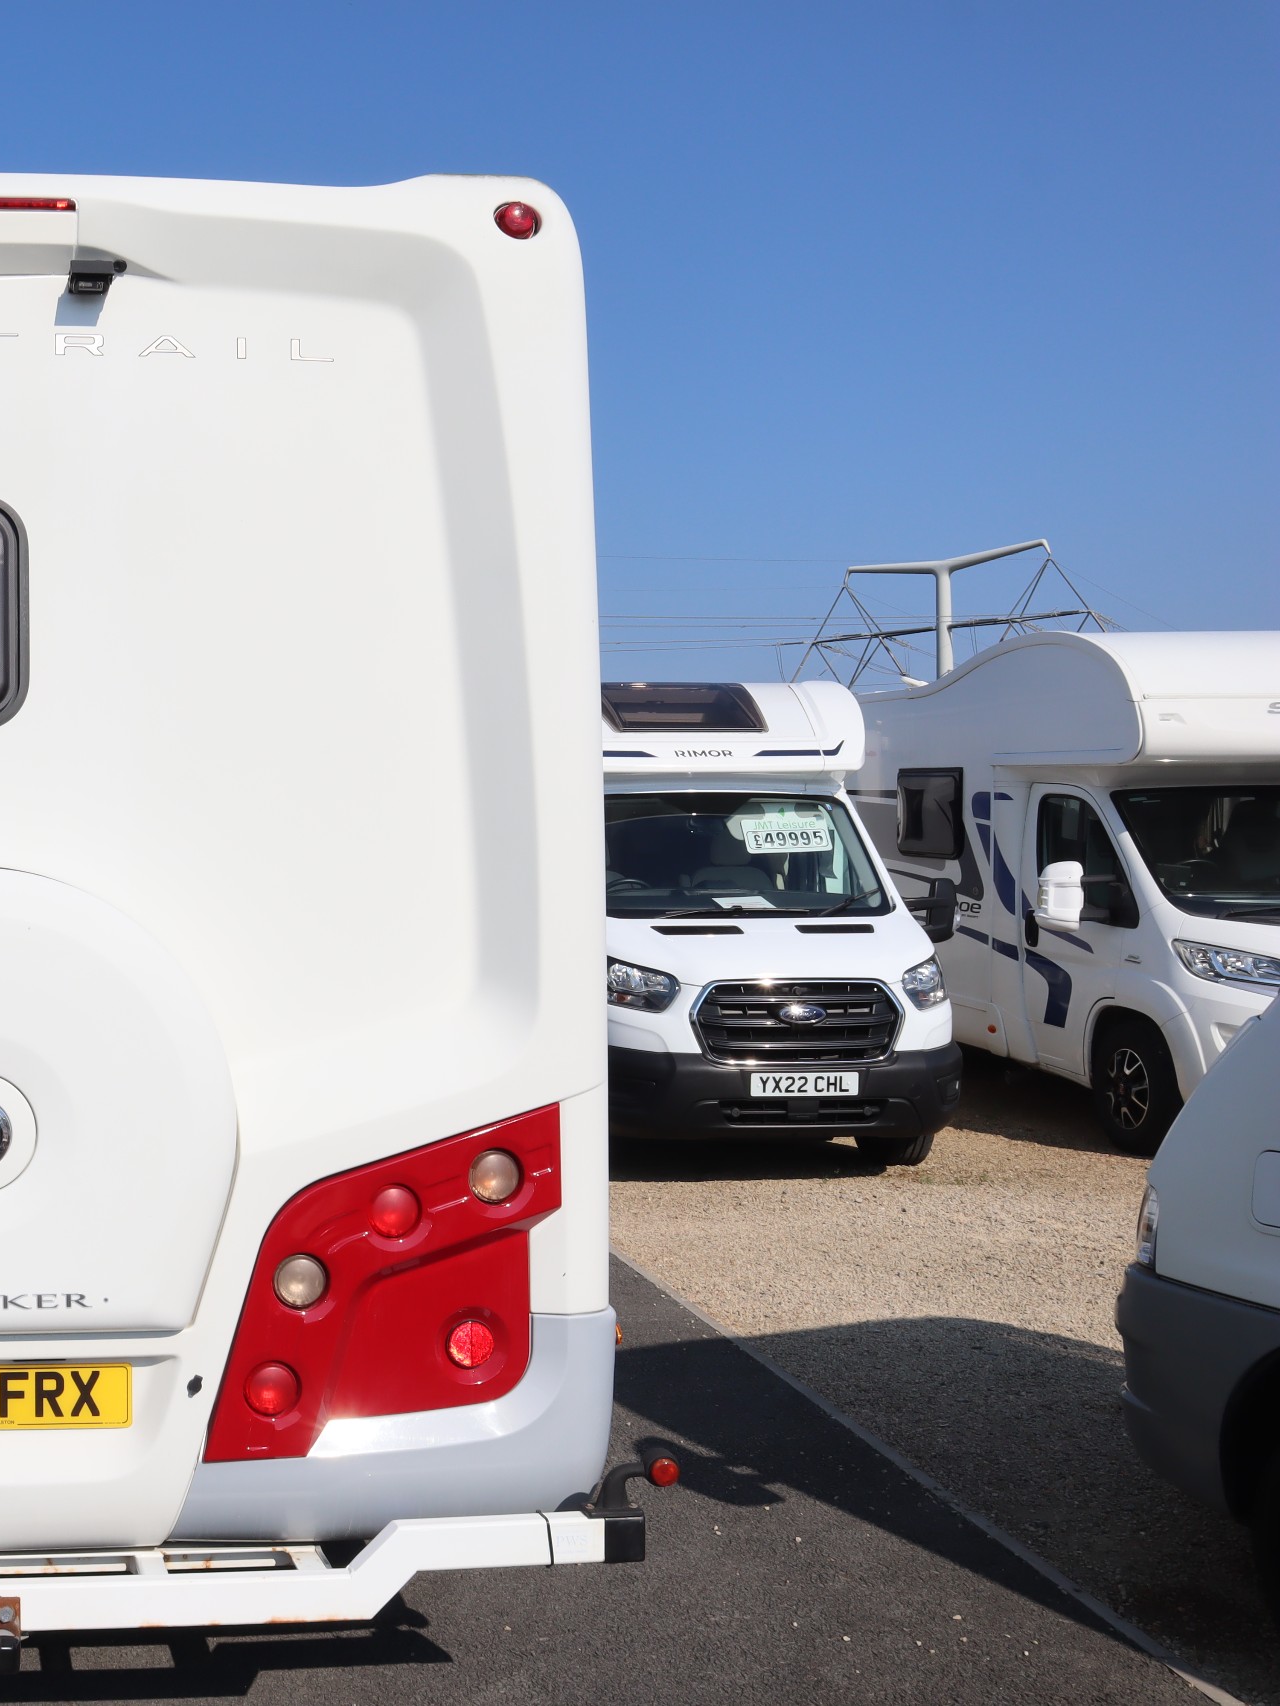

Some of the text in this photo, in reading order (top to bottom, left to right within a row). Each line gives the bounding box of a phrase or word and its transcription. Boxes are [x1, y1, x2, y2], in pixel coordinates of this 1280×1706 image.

[674, 749, 734, 758] RIMOR
[753, 820, 816, 830] JMT Leisure
[753, 831, 824, 849] £49995
[759, 1075, 850, 1093] YX22 CHL
[0, 1370, 101, 1418] FRX
